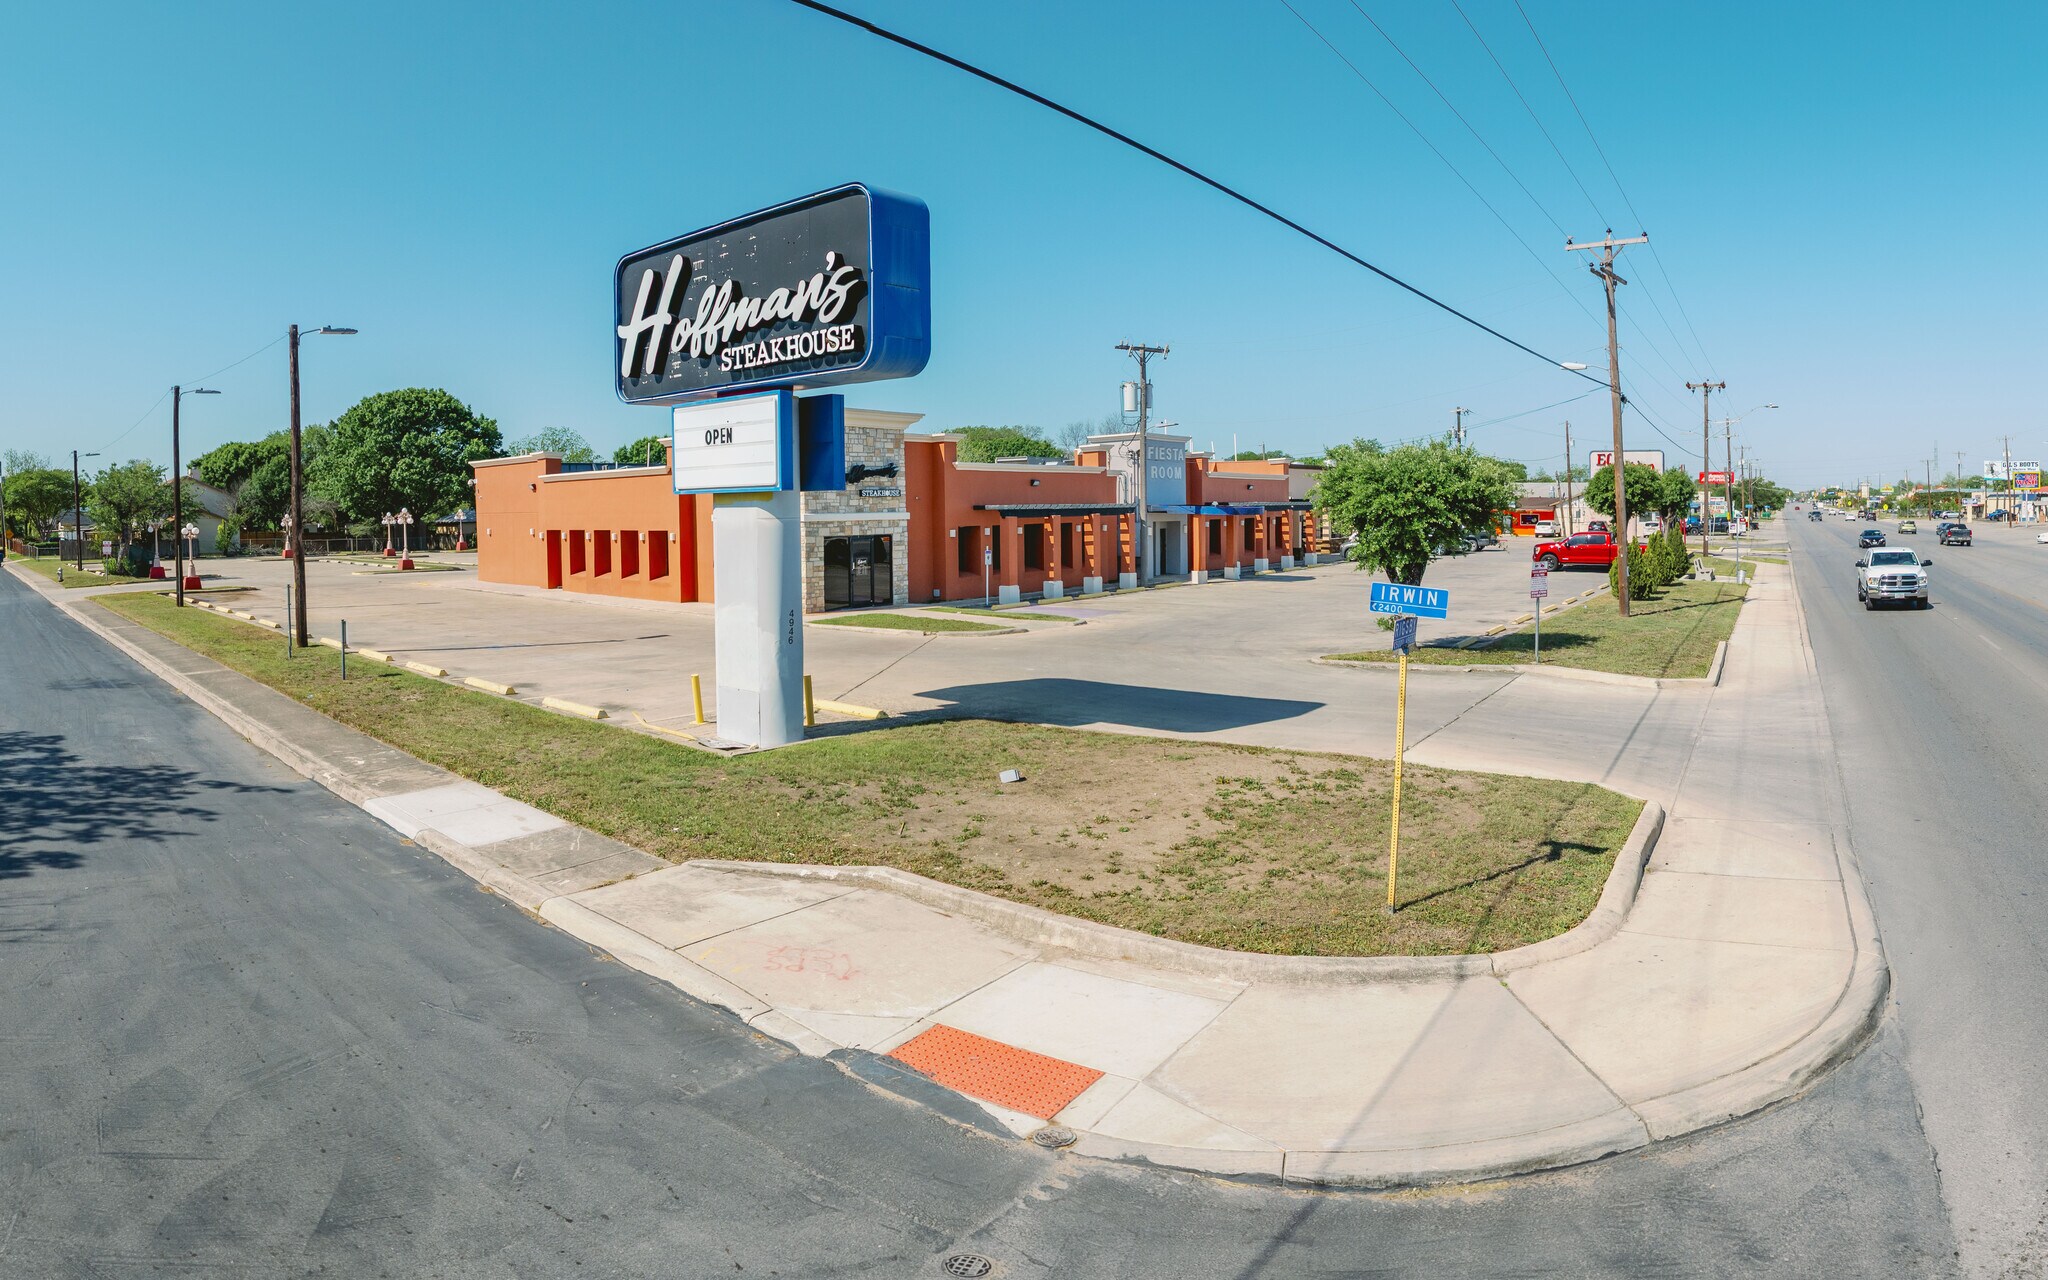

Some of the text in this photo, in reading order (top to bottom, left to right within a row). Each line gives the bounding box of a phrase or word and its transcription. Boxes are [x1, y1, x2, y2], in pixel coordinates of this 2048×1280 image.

[618, 251, 859, 378] Hoffman's
[721, 324, 855, 371] STEAKHOUSE
[705, 427, 732, 445] OPEN
[1148, 446, 1184, 461] FIESTA
[1151, 466, 1182, 479] ROOM
[1381, 586, 1438, 606] IRWIN
[1378, 603, 1403, 613] 2400
